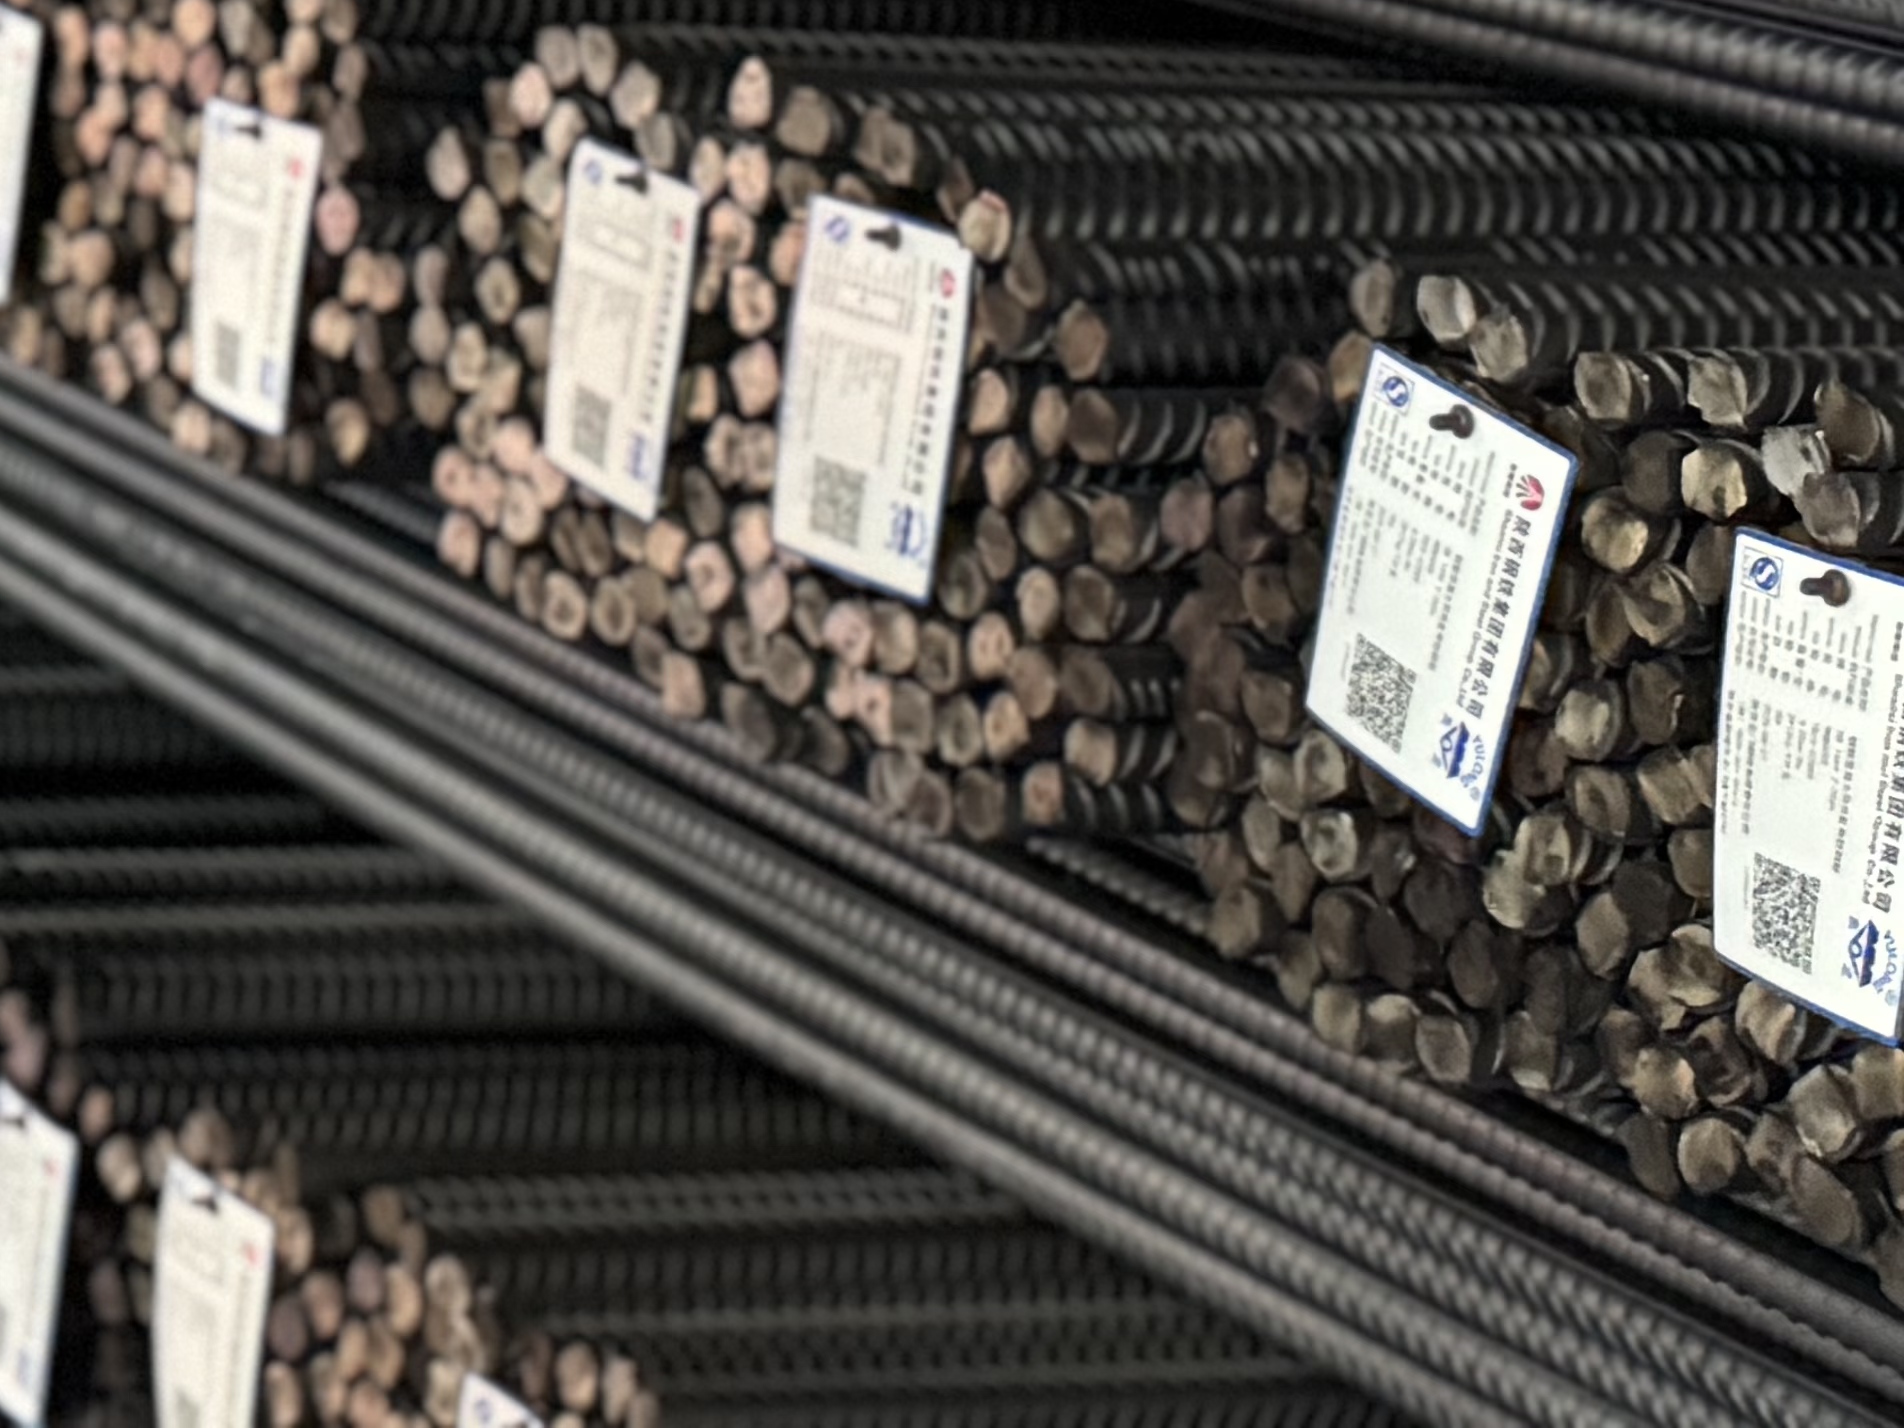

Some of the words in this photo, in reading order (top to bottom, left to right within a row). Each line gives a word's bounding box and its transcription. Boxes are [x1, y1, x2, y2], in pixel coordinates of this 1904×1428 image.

[1465, 512, 1531, 722] 陕西钢铁集团有限公司
[1873, 706, 1904, 913] 铁集团有限公司
